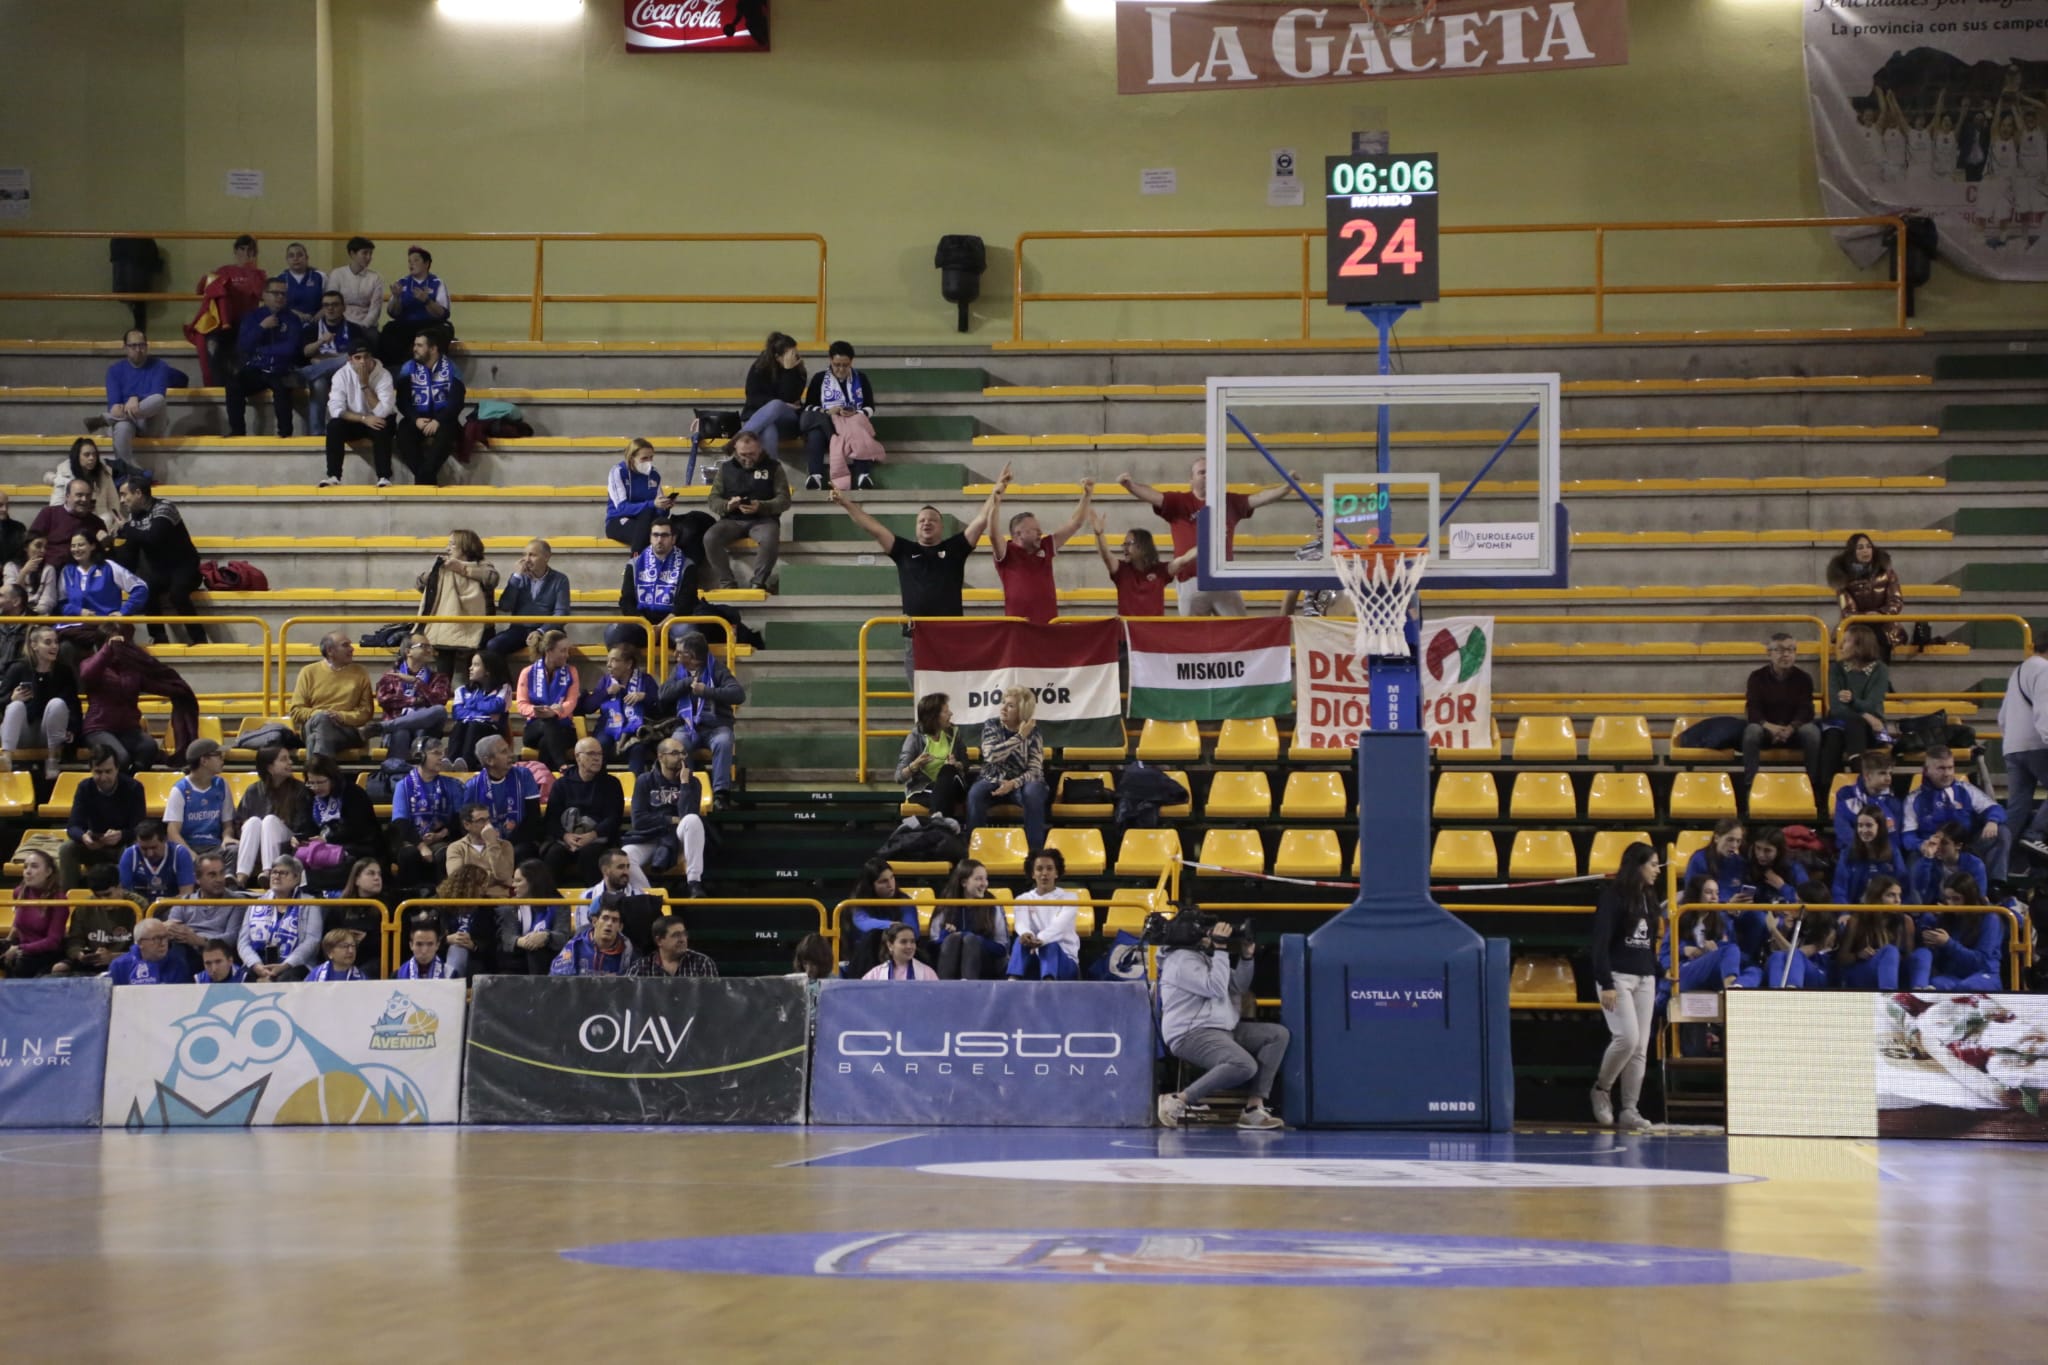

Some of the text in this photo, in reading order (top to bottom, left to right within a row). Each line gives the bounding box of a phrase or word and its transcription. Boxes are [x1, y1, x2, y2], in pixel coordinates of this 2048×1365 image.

[1832, 23, 1848, 35] La
[1854, 20, 1924, 37] provincia
[1929, 22, 1957, 33] con
[1962, 20, 1988, 31] sus
[1146, 1, 1596, 85] LA GACETA
[1333, 160, 1434, 194] 06:06
[1338, 217, 1424, 277] 24
[1476, 532, 1536, 541] EUROLEAGUE
[1476, 541, 1513, 550] WOMEN
[1177, 660, 1245, 681] MISKOLC
[968, 682, 1071, 708] DIÓYŐR
[1311, 692, 1477, 729] DIÓŐR
[1387, 685, 1400, 730] MONDO
[1351, 988, 1443, 1001] CASTILLA Y LEÓN
[371, 1034, 435, 1049] AVENIDA
[838, 1028, 1121, 1058] custo
[21, 1056, 73, 1066] YORK
[838, 1062, 1119, 1076] BARCELONA
[1428, 1101, 1476, 1112] MONDO
